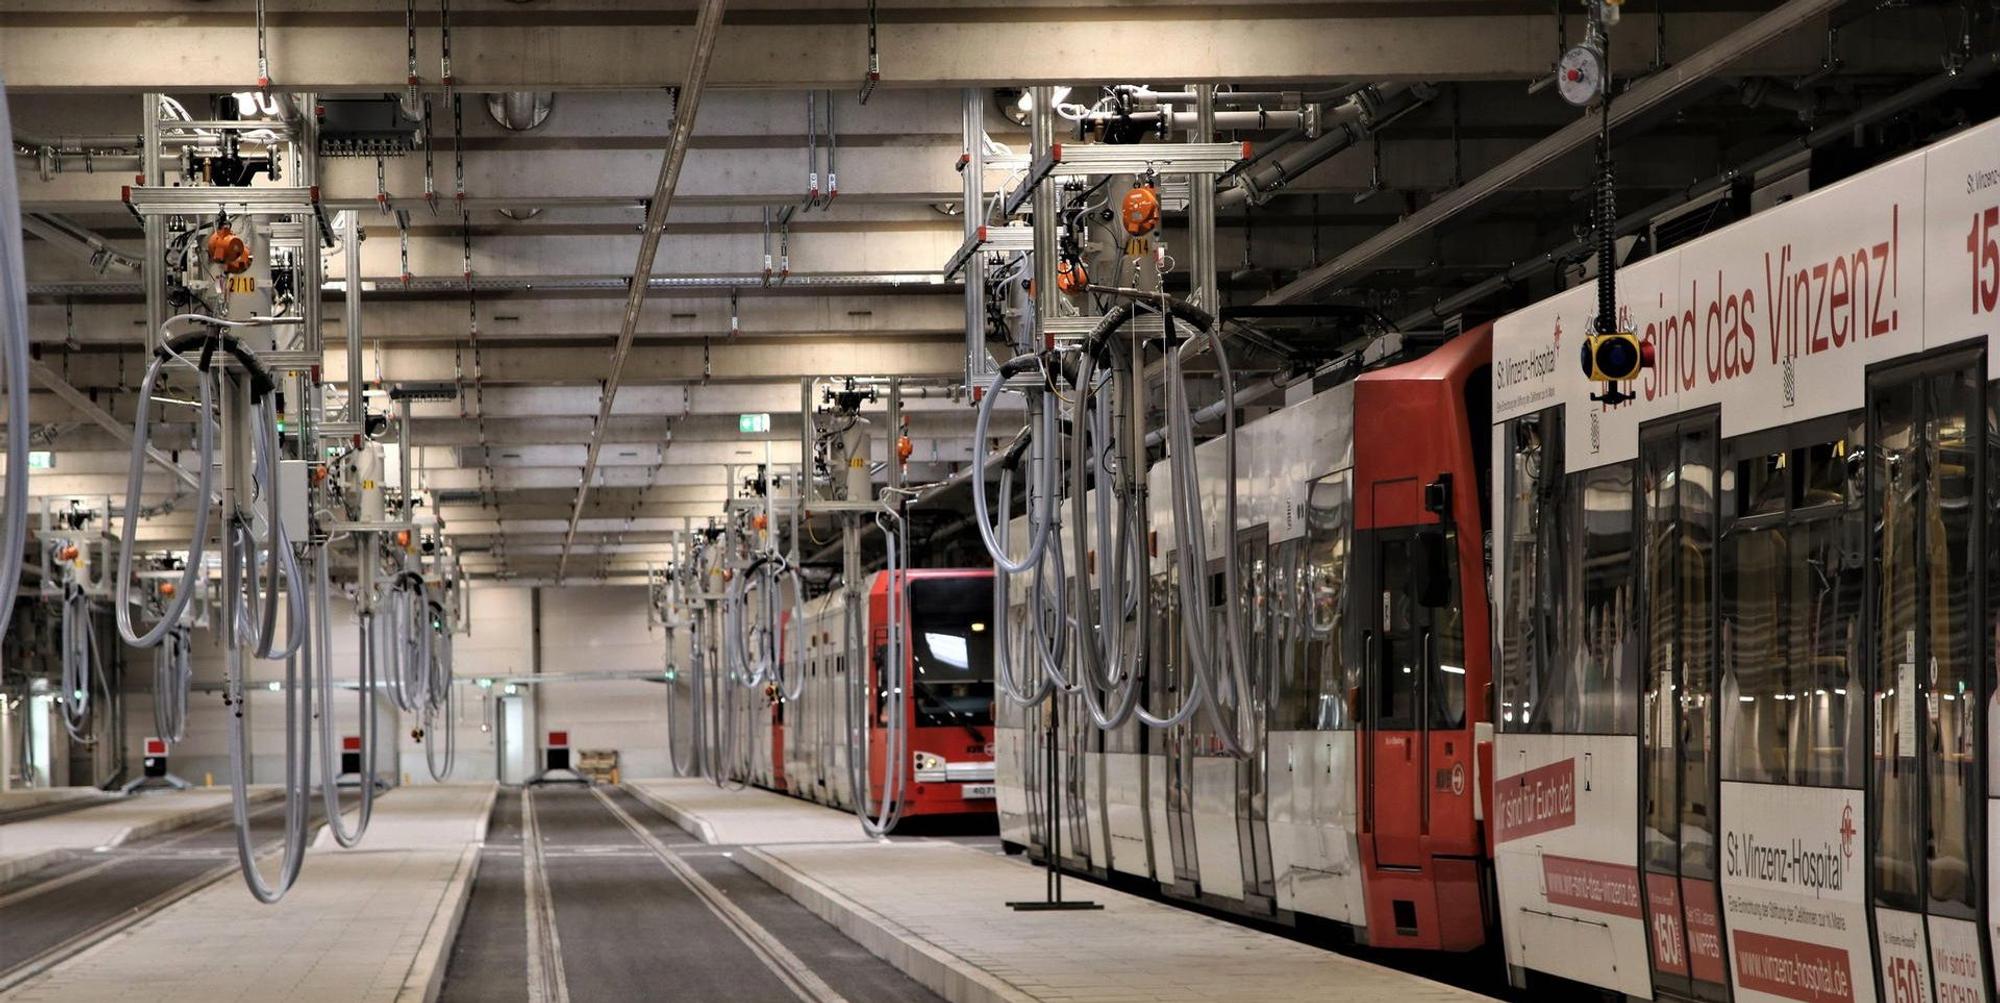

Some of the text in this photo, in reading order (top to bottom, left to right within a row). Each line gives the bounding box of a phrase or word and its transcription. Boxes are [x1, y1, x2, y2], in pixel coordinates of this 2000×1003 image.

[229, 277, 255, 293] 2/10
[1645, 280, 1697, 401] sind
[1706, 270, 1756, 385] das
[1765, 203, 1898, 366] Vinzenz!
[1507, 786, 1523, 828] sind
[1524, 785, 1536, 824] für
[1537, 775, 1558, 820] Euch
[1559, 771, 1573, 815] da!
[1727, 830, 1842, 900] St. Vinzenz-Hospital
[1655, 912, 1678, 965] 150
[1739, 947, 1848, 997] www.vinzenz-hospital.de
[1888, 956, 1922, 1003] 150
